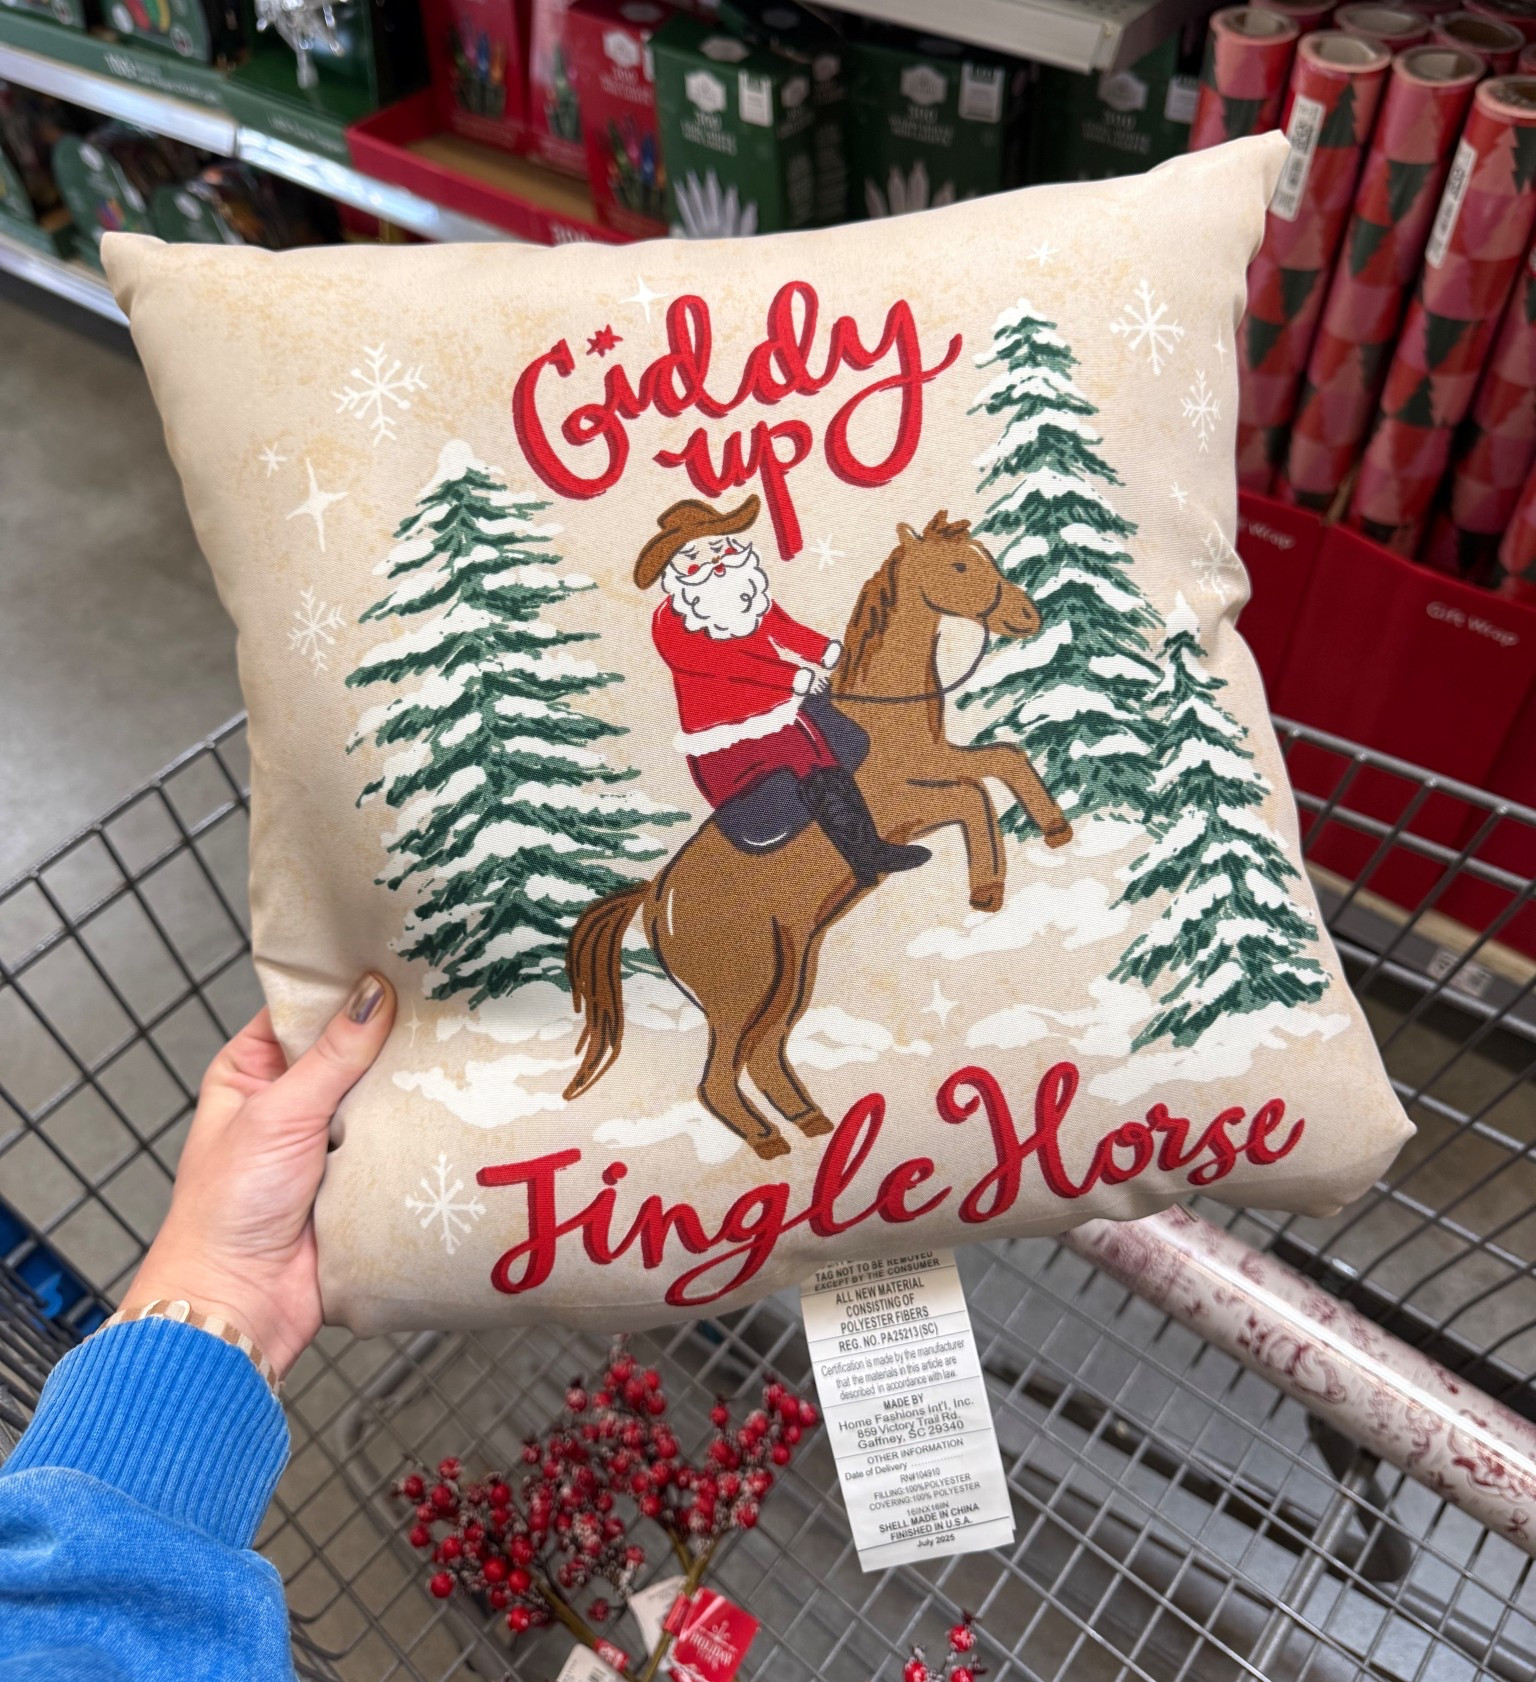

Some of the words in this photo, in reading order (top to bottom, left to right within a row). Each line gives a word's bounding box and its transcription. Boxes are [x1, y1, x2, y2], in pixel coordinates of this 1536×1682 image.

[512, 280, 962, 500] Giddy
[652, 420, 813, 562] up
[1426, 601, 1466, 628] Gift
[1467, 614, 1520, 647] Wrap
[476, 1092, 952, 1306] Jingle
[936, 1061, 1305, 1223] Horse
[814, 1278, 849, 1292] EXCEPT
[851, 1274, 864, 1284] BY
[868, 1270, 885, 1280] THE
[887, 1258, 940, 1276] CONSUMER
[815, 1270, 833, 1282] TAG
[836, 1266, 854, 1278] NOT
[857, 1262, 869, 1273] TO
[871, 1260, 884, 1270] BE
[836, 1292, 853, 1305] ALL
[855, 1286, 877, 1300] NEW
[878, 1276, 924, 1295] MATERIAL
[840, 1314, 894, 1334] POLYESTER
[896, 1306, 930, 1322] FIBERS
[846, 1297, 900, 1318] CONSISTING
[903, 1293, 915, 1306] OF
[821, 1360, 865, 1377] Certification
[866, 1357, 872, 1368] is
[873, 1354, 894, 1367] made
[895, 1352, 904, 1364] by
[904, 1348, 916, 1359] the
[917, 1338, 964, 1357] manufacturer
[839, 1339, 862, 1352] REG.
[863, 1334, 880, 1347] NO.
[836, 1376, 850, 1389] that
[852, 1374, 864, 1385] the
[865, 1366, 898, 1383] materials
[900, 1366, 906, 1376] in
[906, 1362, 920, 1374] this
[921, 1357, 943, 1371] article
[944, 1356, 957, 1367] are
[840, 1386, 876, 1400] described
[877, 1383, 885, 1394] in
[886, 1373, 928, 1392] accordance
[927, 1370, 943, 1382] with
[838, 1419, 872, 1432] Home
[874, 1406, 926, 1424] Fashions
[953, 1397, 974, 1408] Inc.
[883, 1398, 910, 1410] MADE
[912, 1393, 924, 1404] BY
[857, 1426, 877, 1438] 859
[878, 1420, 914, 1435] Victory
[917, 1414, 940, 1428] Trail
[942, 1410, 961, 1420] Rd.
[857, 1434, 906, 1450] Gaffney,
[908, 1427, 926, 1439] SC
[928, 1420, 964, 1436] 29340
[866, 1451, 899, 1464] OTHER
[900, 1438, 964, 1458] INFORMATION
[844, 1470, 864, 1481] Date
[865, 1466, 874, 1476] of
[874, 1462, 908, 1474] Delivery
[933, 1481, 980, 1498] POLYESTER
[879, 1520, 910, 1533] SHELL
[910, 1512, 937, 1525] MADE
[939, 1510, 949, 1518] IN
[950, 1502, 980, 1516] CHINA
[890, 1524, 933, 1541] FINISHED
[934, 1522, 944, 1530] IN
[917, 1537, 934, 1548] July
[936, 1534, 955, 1543] 2025
